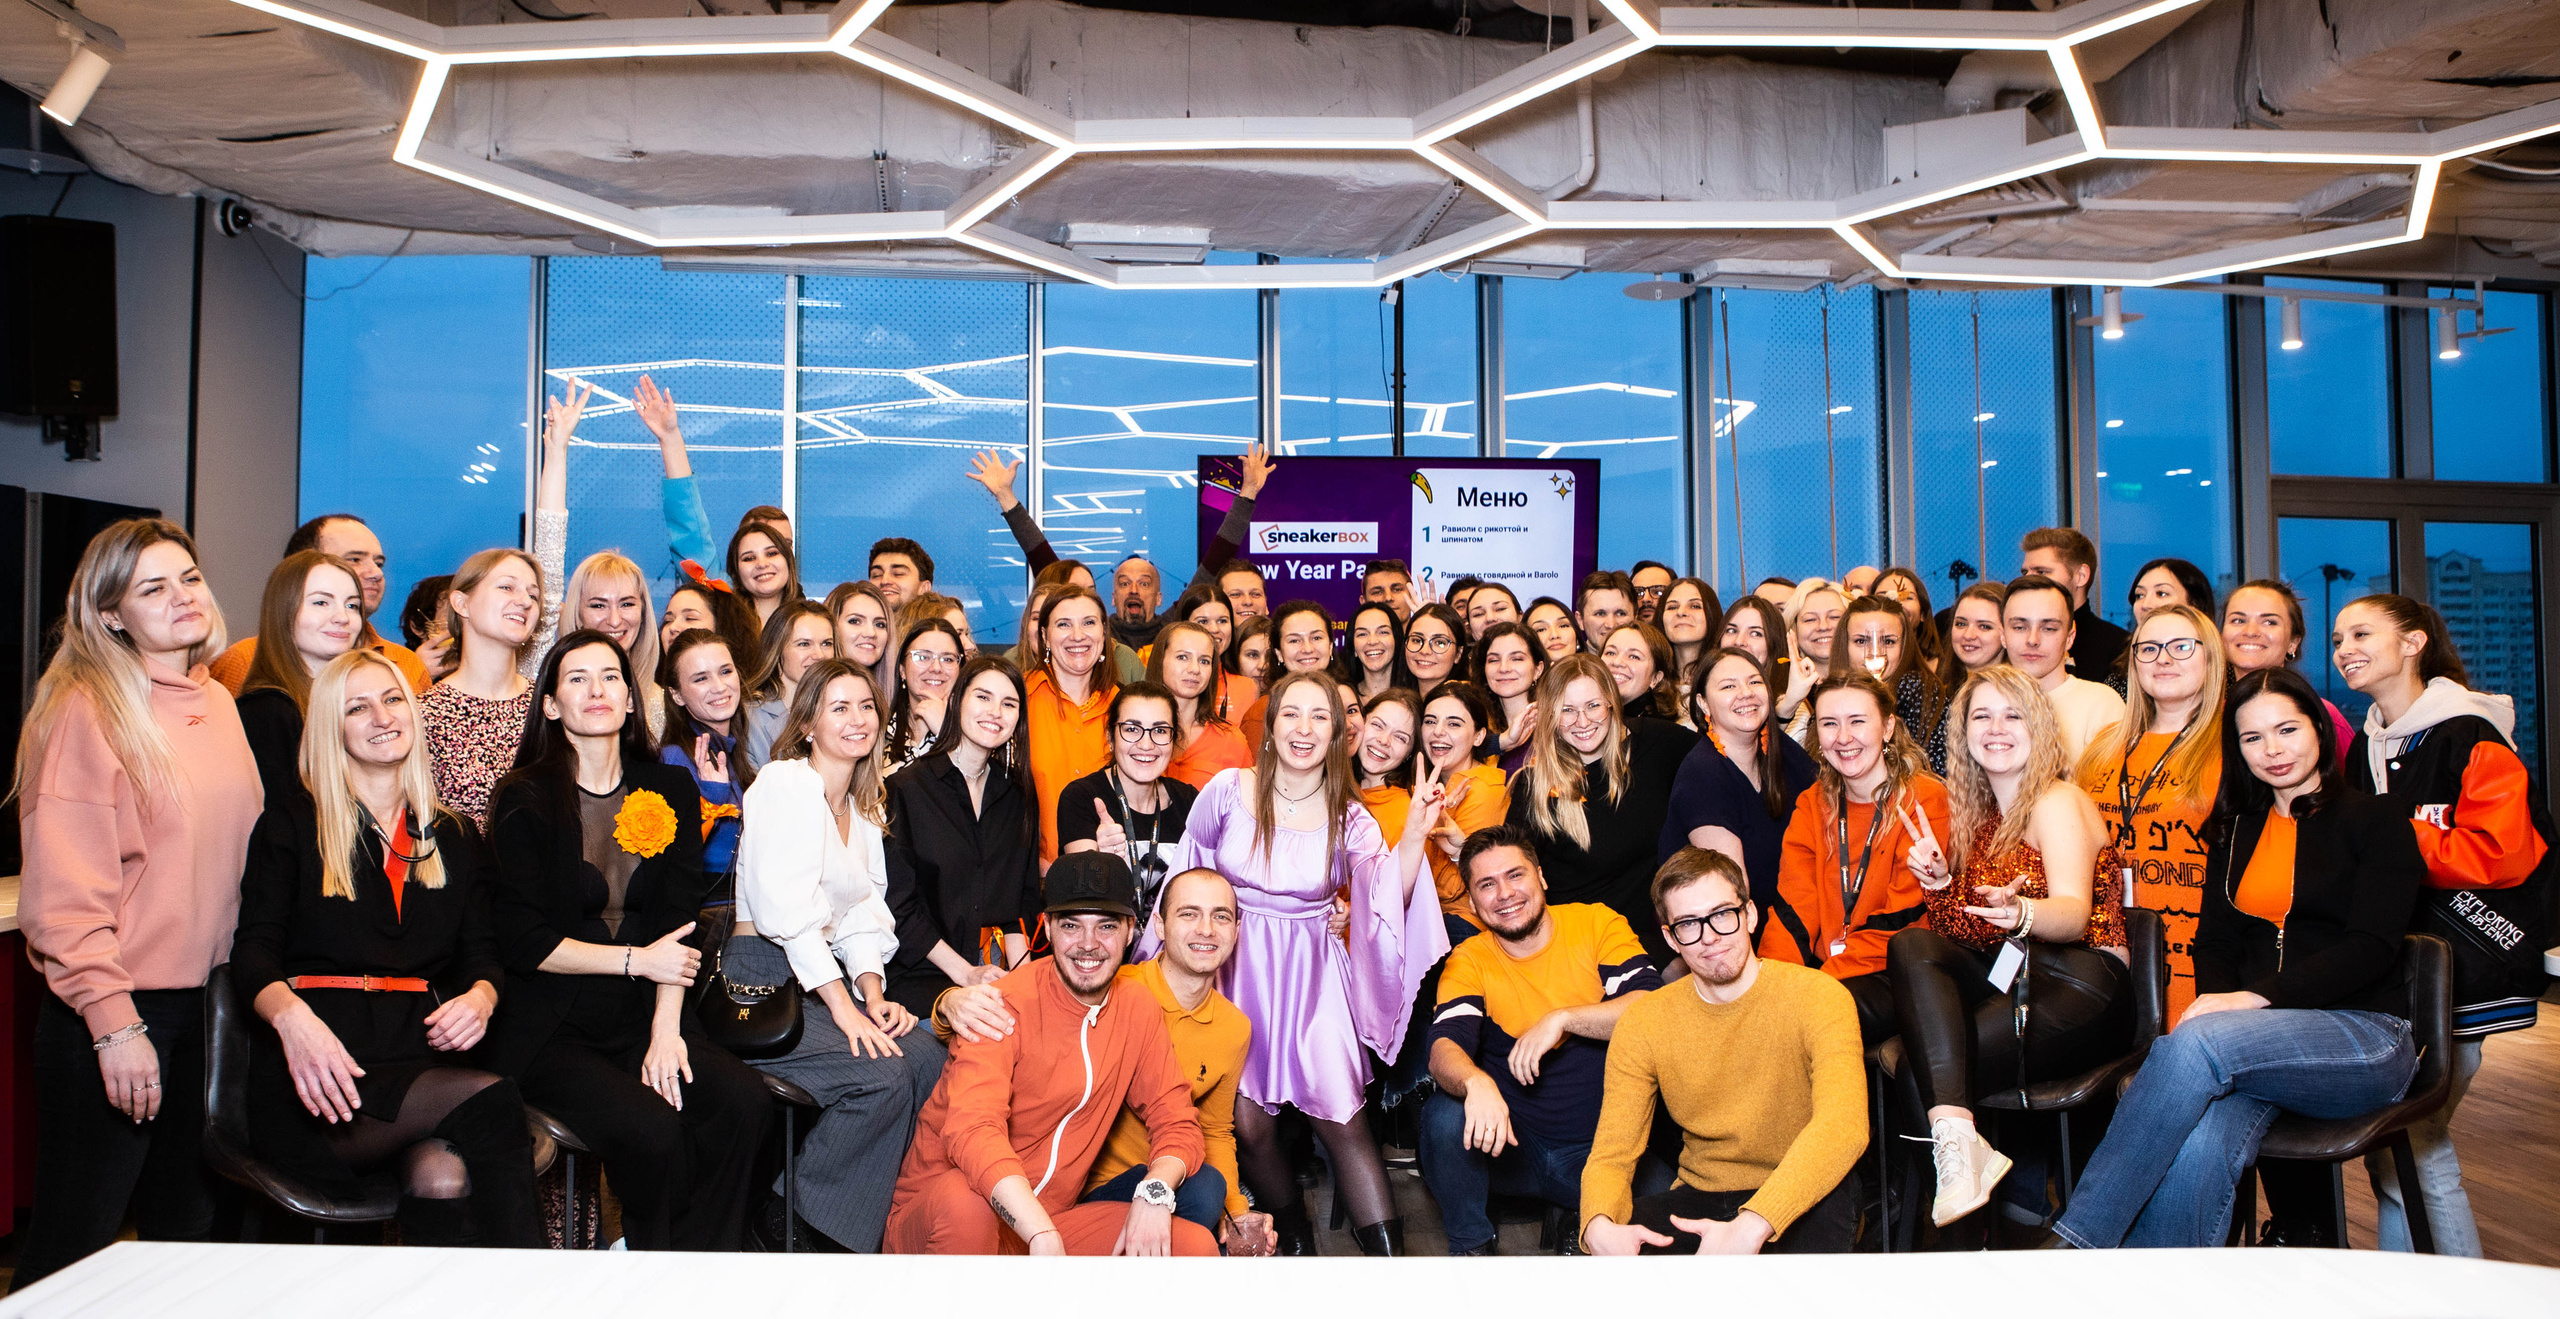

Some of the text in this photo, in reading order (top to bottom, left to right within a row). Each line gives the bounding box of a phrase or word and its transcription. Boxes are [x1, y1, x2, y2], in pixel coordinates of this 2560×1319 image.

[1457, 486, 1528, 508] Меню
[1422, 526, 1430, 543] 1
[1441, 525, 1476, 533] Равиоли
[1484, 525, 1522, 535] рикоттой
[1285, 559, 1336, 580] Year
[1341, 559, 1367, 580] Pa
[1422, 566, 1433, 583] 2
[1483, 571, 1526, 579] говядиной
[1534, 570, 1559, 579] Barolo
[2449, 896, 2516, 951] THE ABSENCE
[2456, 890, 2525, 943] EXPLORING
